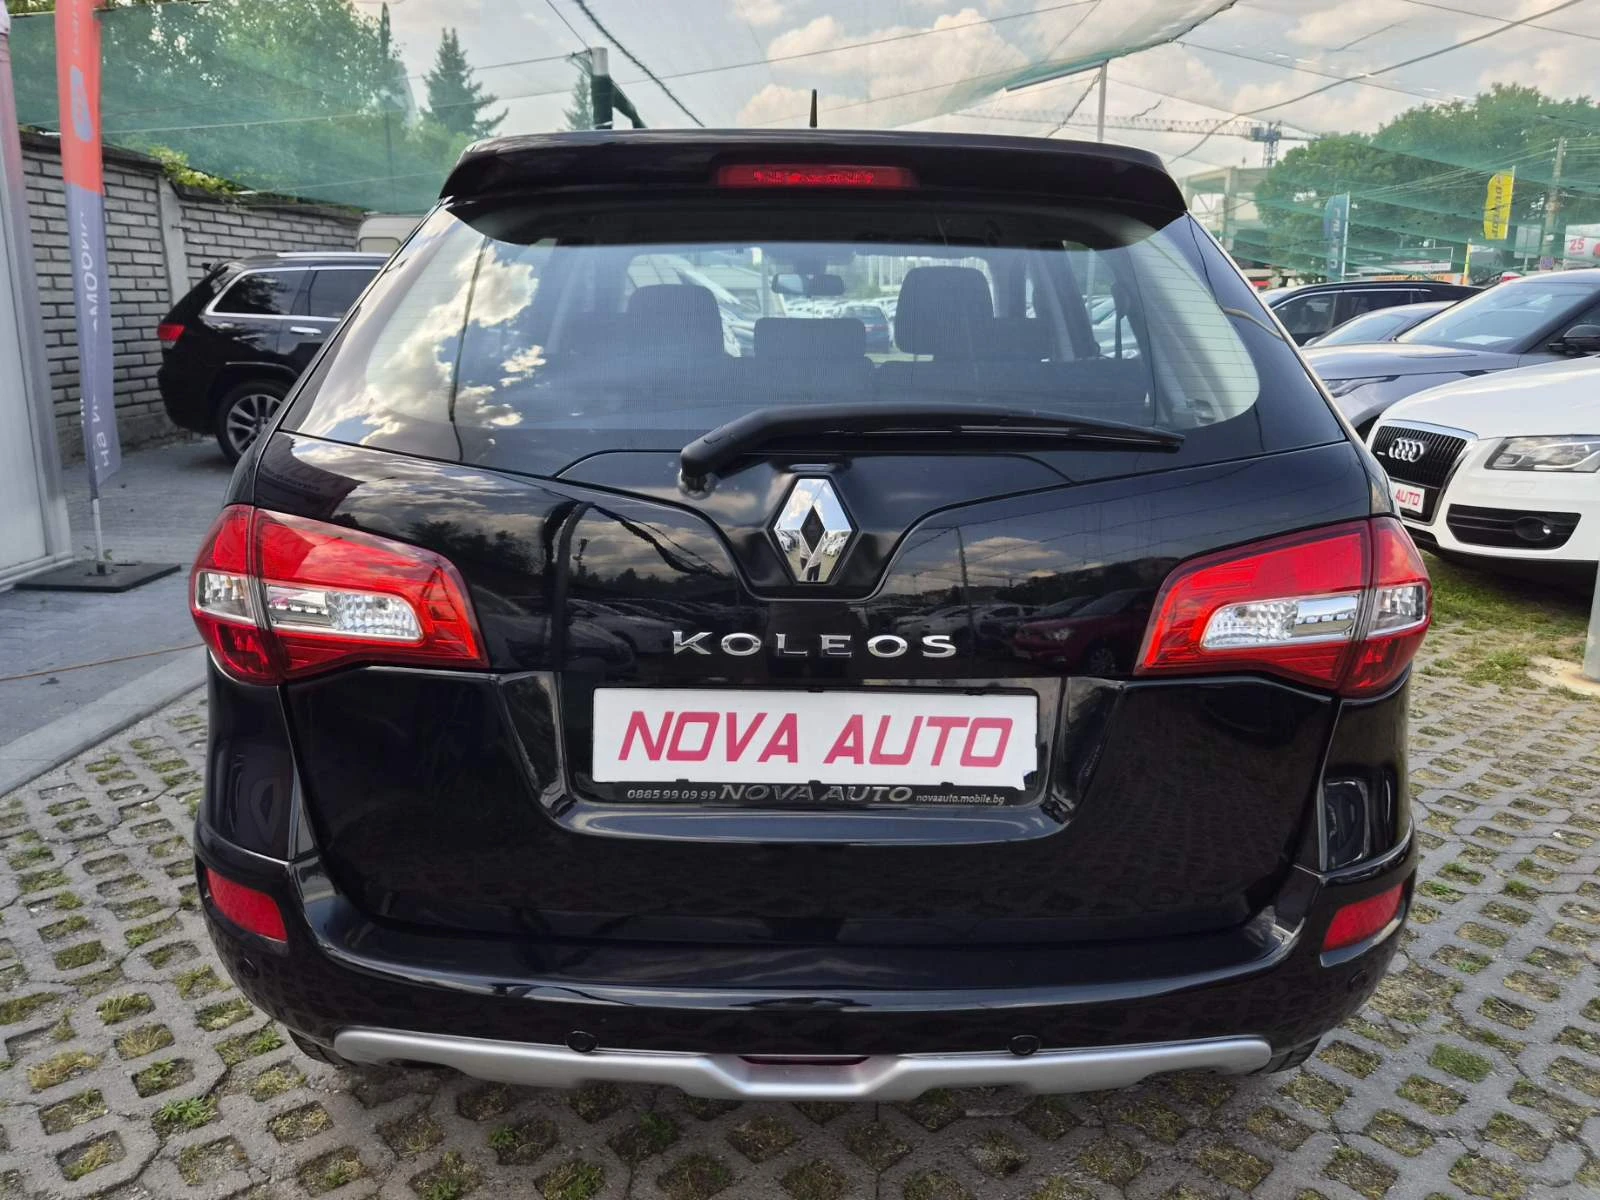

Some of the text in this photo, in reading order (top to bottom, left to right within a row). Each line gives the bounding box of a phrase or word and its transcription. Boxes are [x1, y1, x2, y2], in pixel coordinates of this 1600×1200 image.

[1396, 489, 1420, 506] AUTO
[672, 630, 957, 658] KOLEOS
[618, 710, 1014, 768] NOVA AUTO
[719, 784, 814, 801] NOVA
[819, 785, 913, 802] AUTO
